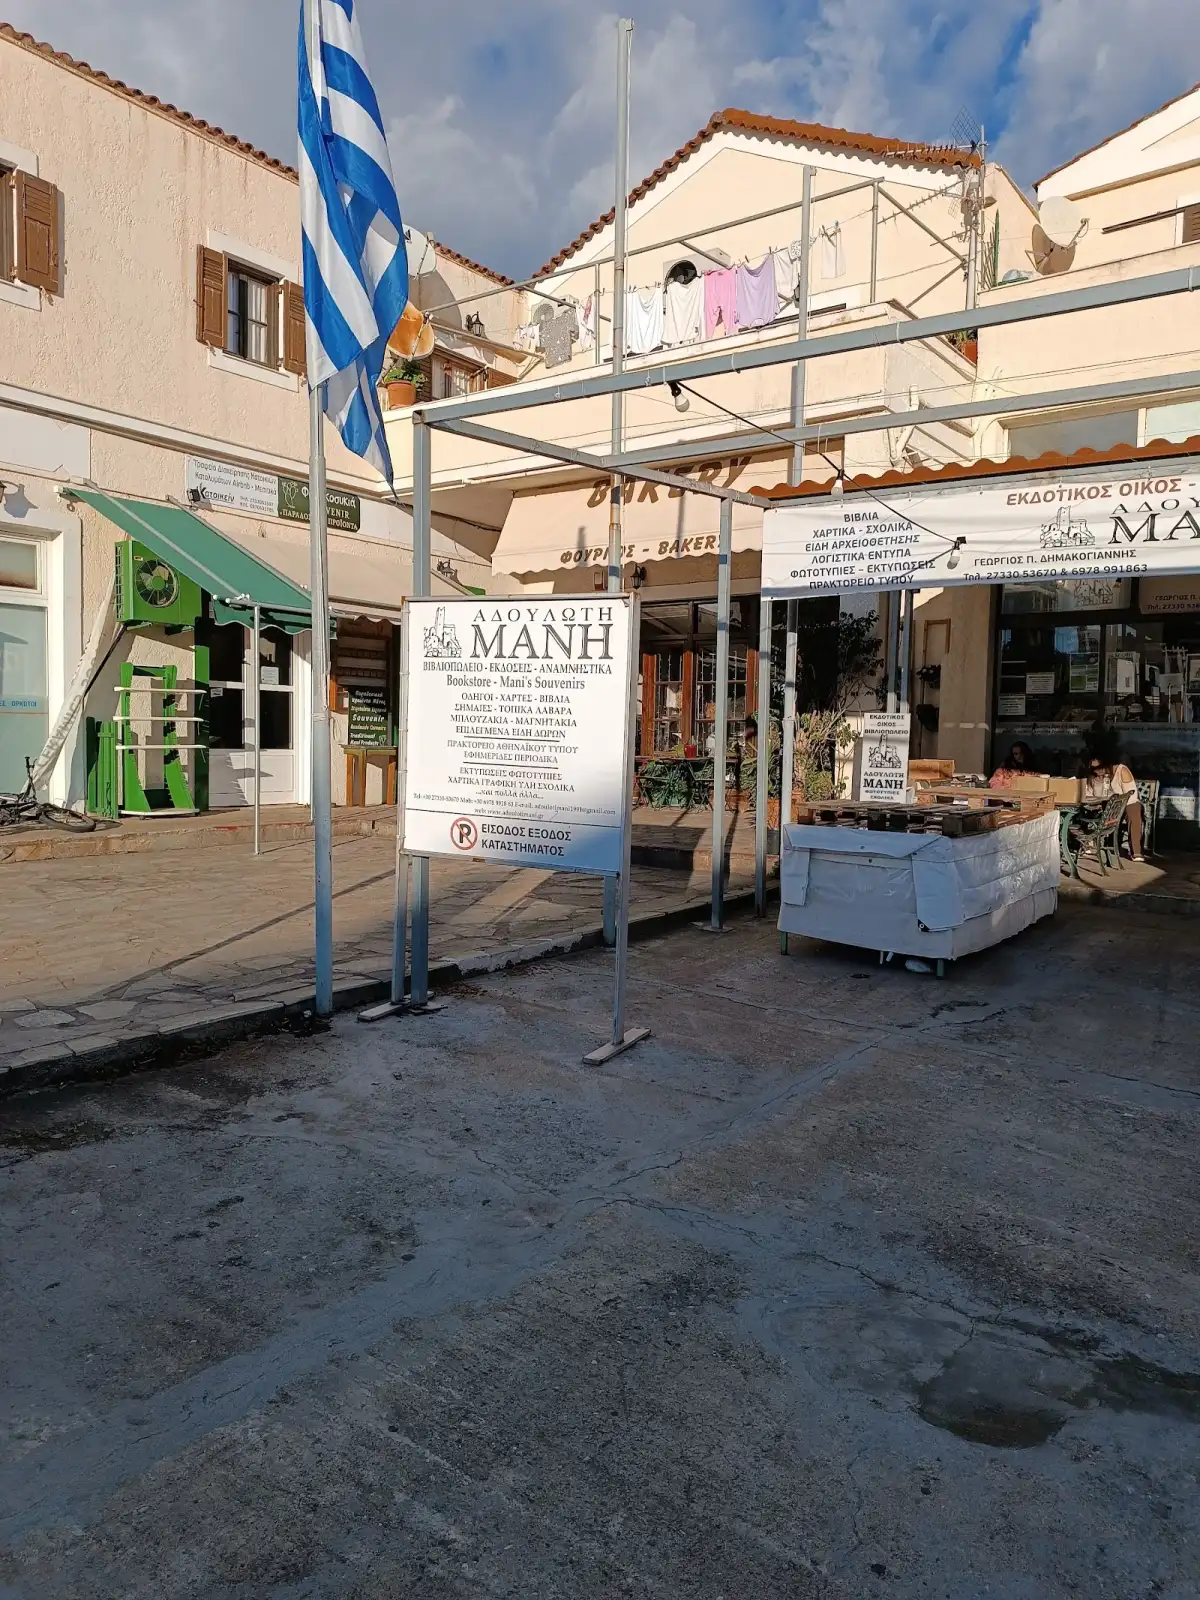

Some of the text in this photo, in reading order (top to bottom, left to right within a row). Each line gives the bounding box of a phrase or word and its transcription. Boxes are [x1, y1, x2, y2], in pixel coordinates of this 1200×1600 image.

[1006, 485, 1113, 506] ΕΚΔΟΤΙΚΟΣ
[1119, 478, 1182, 497] ΟΙΚΟΣ
[844, 511, 879, 523] ΒΙΒΛΙΑ
[812, 526, 856, 538] ΧΑΡΤΙΚΑ
[866, 522, 913, 534] ΣΧΟΛΙΚΑ
[658, 534, 722, 556] BAKER
[805, 534, 920, 552] ΕΙΔΗ ΑΡΧΕΙΟΘΕΤΗΣΗΣ
[811, 548, 912, 564] ΛΟΓΙΣΤΙΚΑ ΕΝΤΥΠΑ
[974, 549, 1137, 567] ΓΕΩΡΓΙΟΣ Π. ΔΗΜΑΚΟΓΙΑΝΝΗΣ
[790, 565, 856, 579] ΦΩΤΟΤΥΠΙΕΣ
[867, 560, 936, 573] ΕΚΤΥΠΩΣΕΙΣ
[986, 569, 1019, 581] 27330
[1023, 568, 1057, 578] 53670
[1060, 568, 1068, 576] &
[1072, 566, 1100, 576] 6978
[1104, 564, 1148, 575] 991863
[809, 574, 914, 590] ΠΡΑΚΤΟΡΕΙΟ ΤΥΠΟΥ
[473, 606, 613, 623] ΑΔΟΥΛΩΤΗ
[470, 623, 614, 660] ΜΑΝΗ
[423, 661, 483, 673] ΒΙΒΛΙΟΠΩΛΕΙΟ
[489, 662, 532, 674] ΕΚΔΟΣΕΙΣ
[539, 663, 613, 675] ΑΝΑΜΝΗΣΤΙΚΑ
[446, 674, 492, 688] Bookstore
[500, 675, 533, 689] Mani's
[534, 676, 586, 690] Souvenirs
[461, 692, 494, 702] ΟΔΗΓΟΙ
[500, 693, 533, 703] ΧΑΡΤΕΣ
[539, 694, 570, 704] ΒΙΒΛΙΑ
[454, 703, 492, 713] ΣΗΜΑΙΕΣ
[498, 704, 533, 714] ΤΟΠΙΚΑ
[535, 705, 573, 715] ΛΑΒΑΡΑ
[352, 714, 385, 723] Souvenir
[450, 714, 509, 725] ΜΠΛΟΥΖΑΚΙΑ
[515, 716, 577, 728] ΜΑΓΝΗΤΑΚΙΑ
[455, 725, 566, 739] ΕΠΙΛΕΓΜΕΝΑ ΕΙΔΗ ΔΩΡΩΝ
[447, 740, 495, 751] ΠΡΑΚΤΟΡΕΙΟ
[548, 744, 579, 754] ΤΥΠΟΥ
[464, 750, 558, 764] ΕΦΗΜΕΡΙΔΕΣ ΠΕΡΙΟΔΙΚΑ
[460, 767, 563, 781] ΕΚΤΥΠΩΣΕΙΣ ΦΩΤΟΤΥΠΙΕΣ
[447, 776, 575, 792] ΧΑΡΤΙΚΑ ΓΡΑΦΙΚΗ ΥΛΗ ΣΧΟΛΙΚΑ
[863, 778, 904, 789] ΜΑΝΗ
[481, 823, 572, 842] ΕΙΣΟΔΟΣ ΕΞΟΔΟΣ
[481, 839, 564, 857] ΚΑΤΑΣΤΗΜΑΤΟΣ
